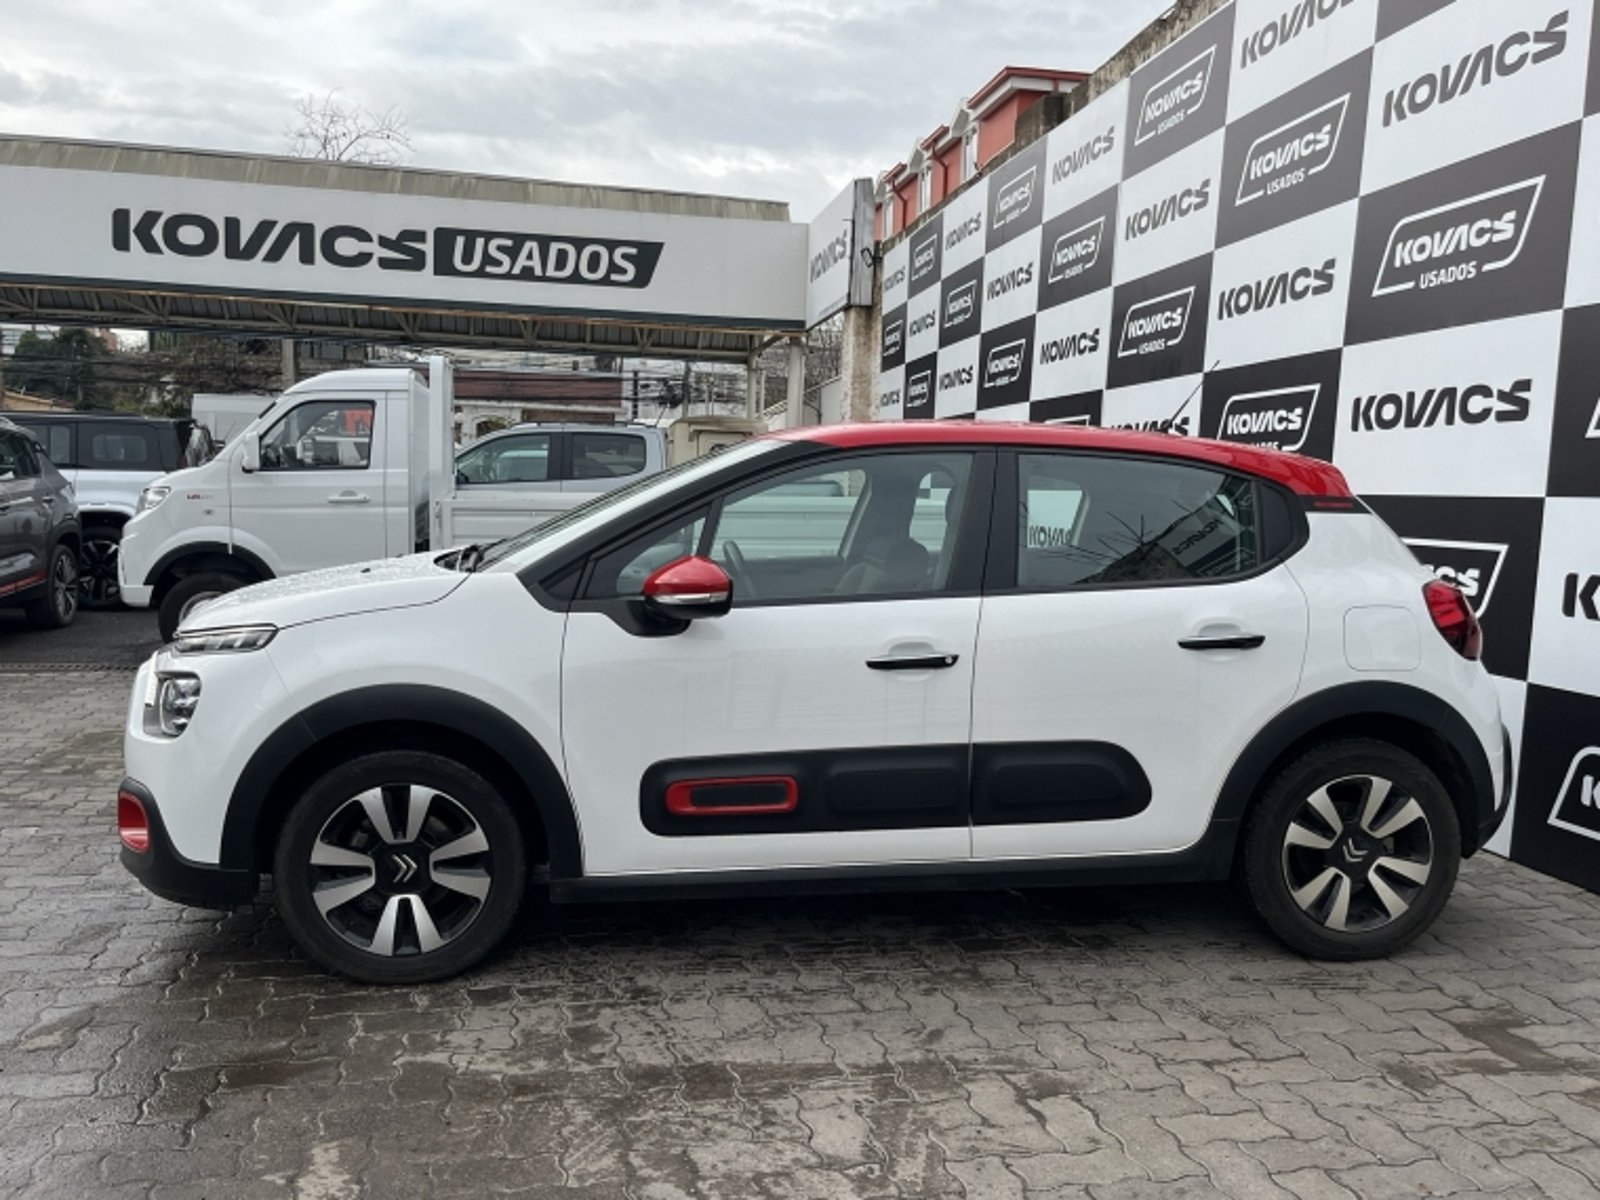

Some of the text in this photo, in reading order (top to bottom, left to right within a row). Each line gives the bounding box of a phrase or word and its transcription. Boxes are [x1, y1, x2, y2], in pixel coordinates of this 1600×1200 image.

[1382, 10, 1570, 128] KOVACS
[1145, 71, 1203, 123] KOVACS
[1052, 125, 1115, 184] KOVACS
[1250, 123, 1331, 180] KOVACS
[1266, 168, 1306, 195] USADOS
[1125, 178, 1211, 241] KOVACS
[111, 207, 639, 283] KOVACS USADOS
[1056, 235, 1096, 266] KOVACS
[1393, 210, 1517, 268] KOVACS
[986, 261, 1034, 301] KOVACS
[1218, 258, 1337, 321] KOVACS
[1419, 261, 1477, 289] USADOS
[1039, 328, 1100, 365] KOVACS
[1128, 307, 1183, 340] KOVACS
[1227, 407, 1303, 435] KOVACS
[1351, 378, 1532, 432] KOVACS
